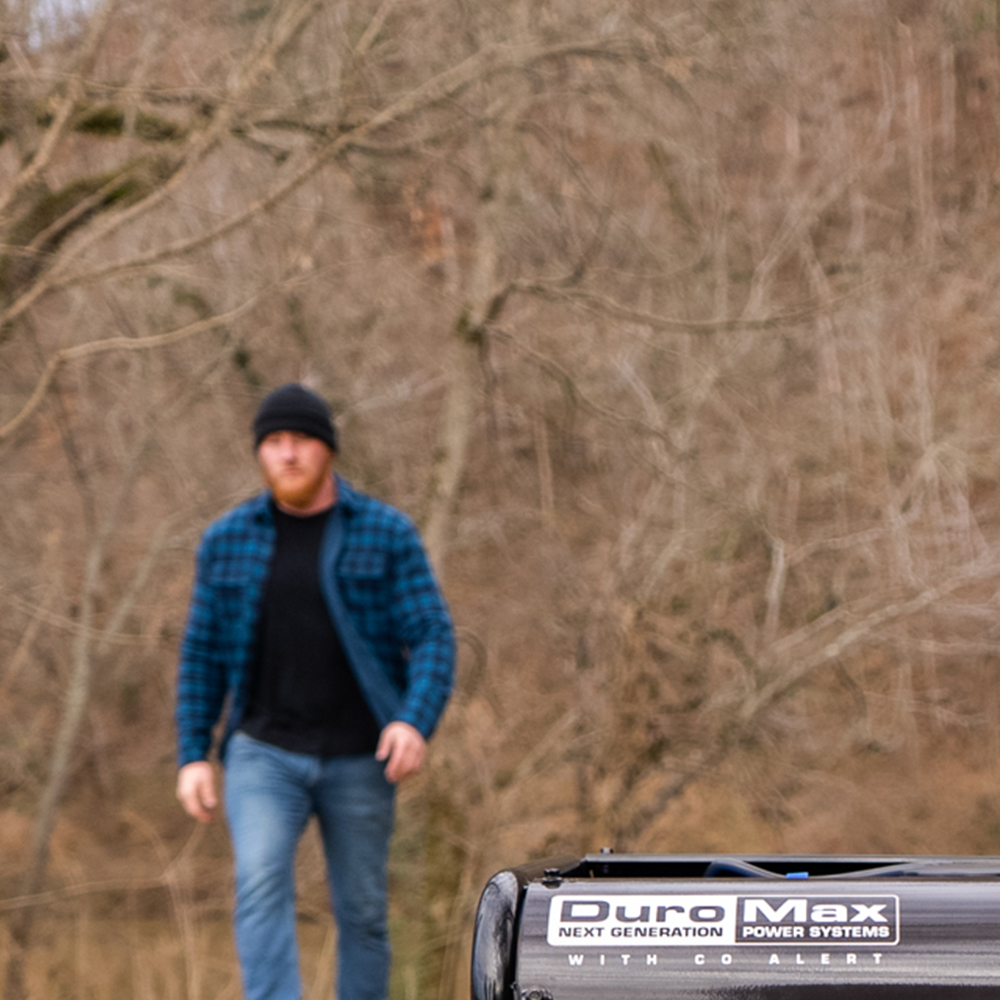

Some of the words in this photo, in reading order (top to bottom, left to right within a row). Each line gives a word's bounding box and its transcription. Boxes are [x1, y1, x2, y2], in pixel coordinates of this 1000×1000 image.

[558, 926, 604, 938] NEXT
[610, 926, 723, 938] GENERATION
[742, 926, 805, 938] POWER
[809, 926, 891, 938] SYSTEMS
[568, 953, 659, 966] WITH
[694, 953, 733, 965] CO
[768, 952, 883, 965] ALERT
